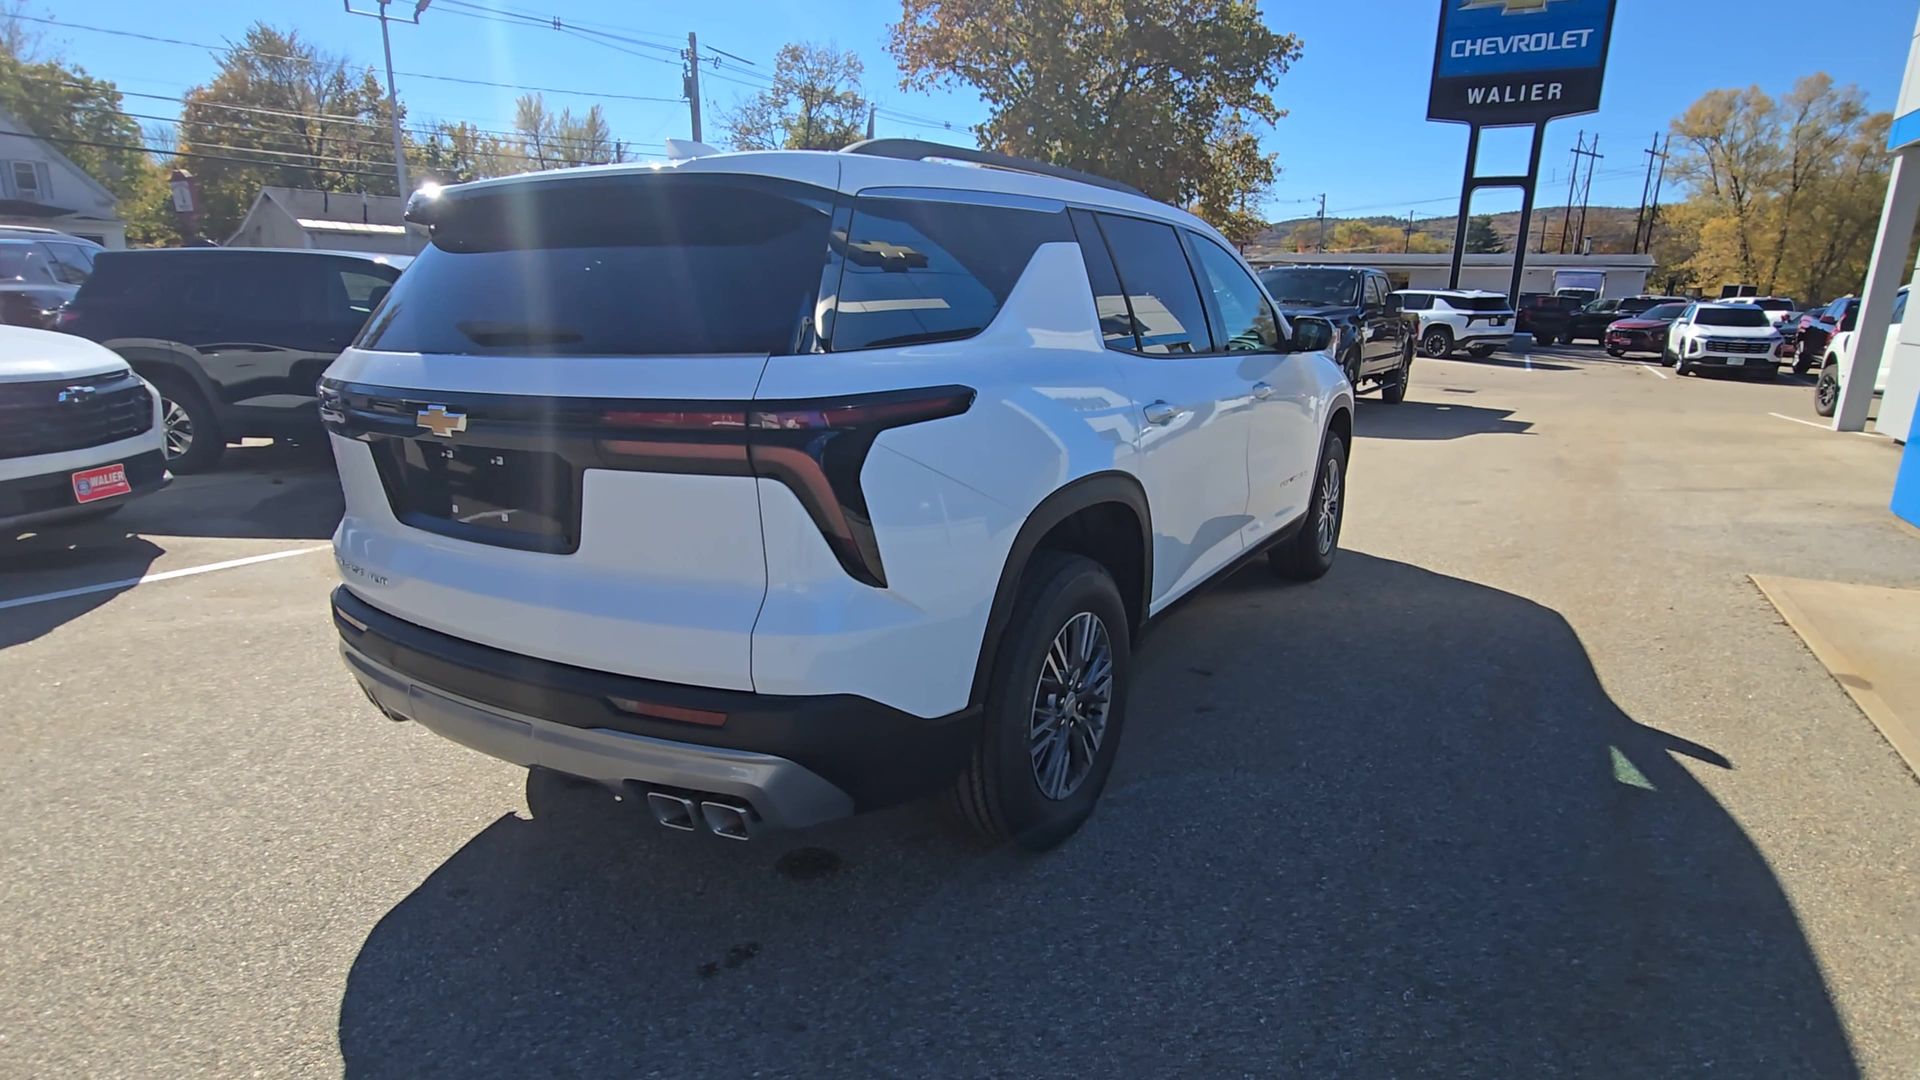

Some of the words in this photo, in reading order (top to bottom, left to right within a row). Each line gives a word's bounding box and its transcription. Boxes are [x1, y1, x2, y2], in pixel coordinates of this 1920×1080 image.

[1451, 29, 1594, 58] CHEVROLET
[1467, 82, 1563, 104] WALIER
[90, 470, 125, 487] WALIER
